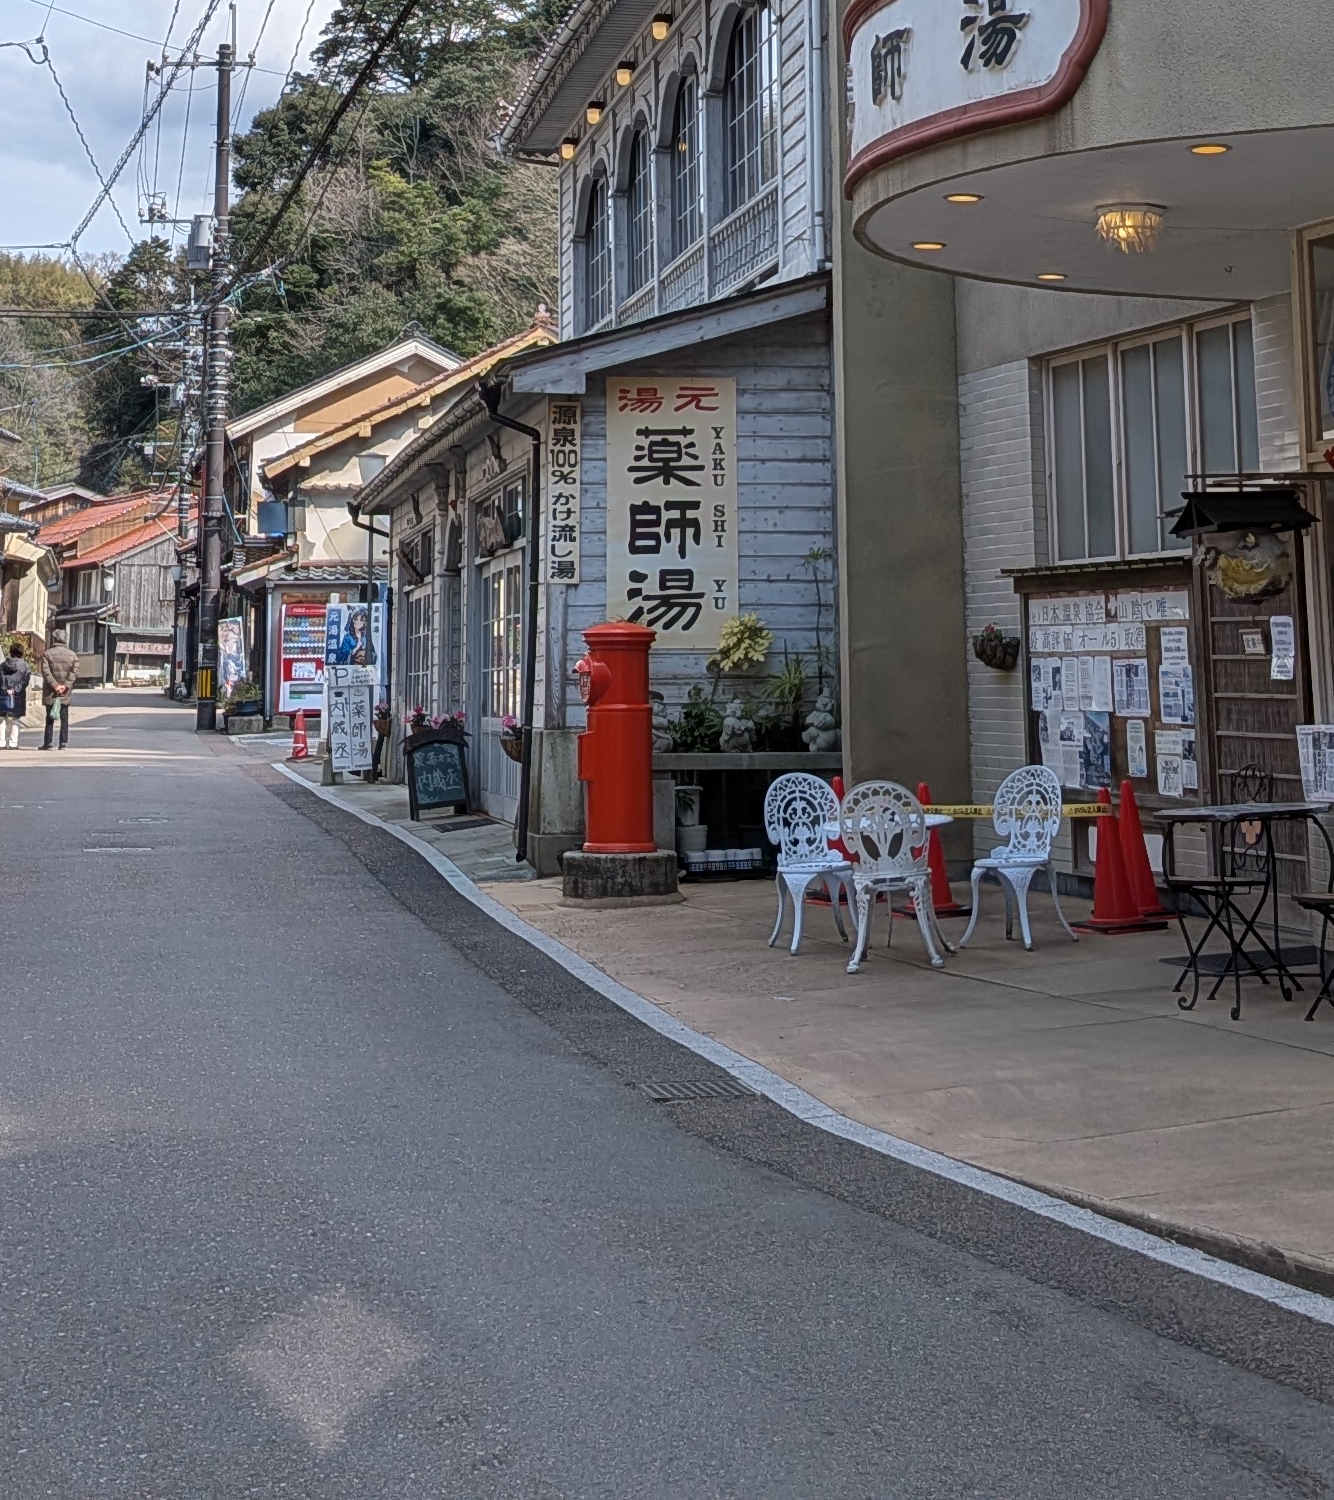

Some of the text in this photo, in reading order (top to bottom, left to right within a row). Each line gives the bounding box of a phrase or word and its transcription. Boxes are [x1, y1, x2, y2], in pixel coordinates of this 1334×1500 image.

[617, 386, 720, 414] 湯元
[626, 425, 706, 632] 薬師湯
[710, 426, 727, 610] YAKU SHI YU
[328, 610, 341, 665] 元湯温泉
[332, 666, 349, 686] P
[351, 699, 369, 759] 薬師湯
